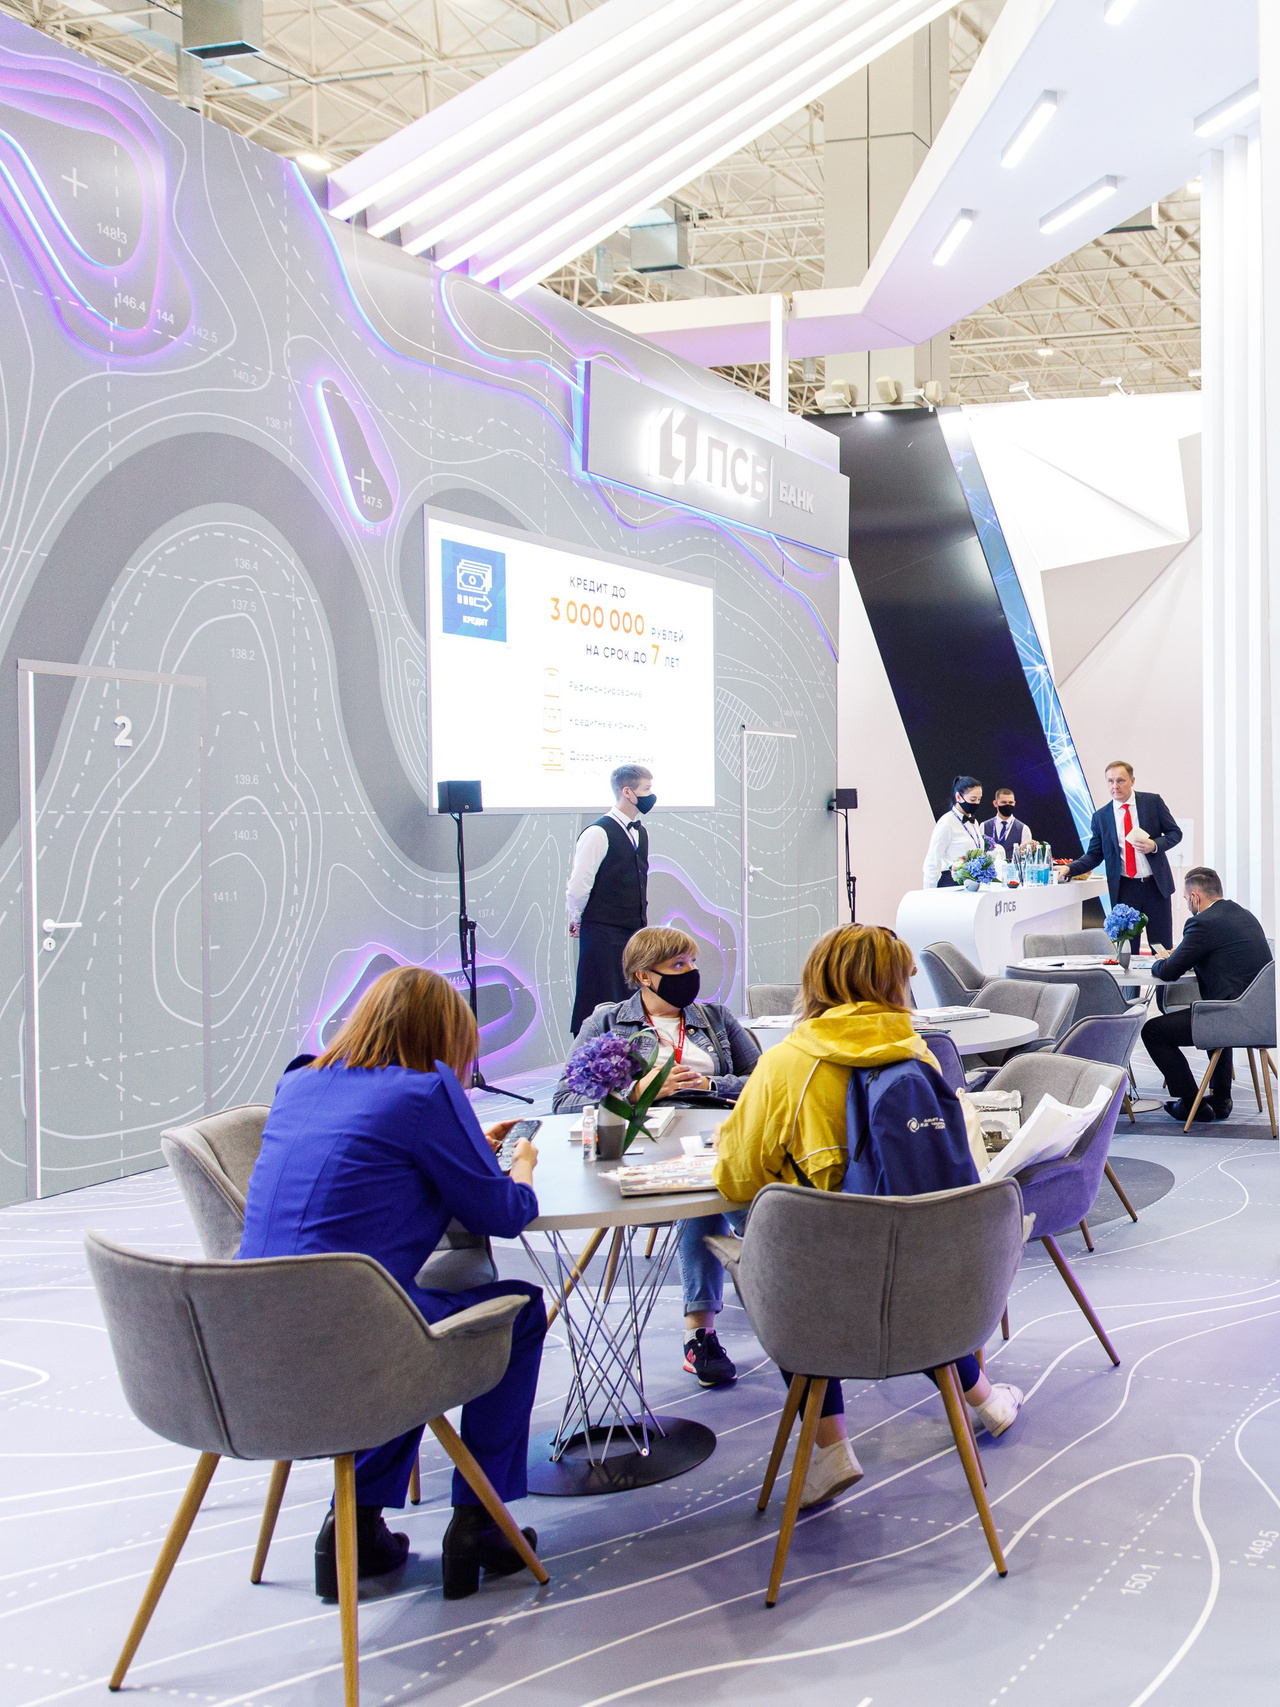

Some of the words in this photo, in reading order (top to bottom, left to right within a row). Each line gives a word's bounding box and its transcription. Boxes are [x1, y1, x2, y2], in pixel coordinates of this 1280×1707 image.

[116, 293, 147, 312] 146.4
[156, 308, 175, 325] 144
[191, 324, 218, 343] 142.5
[232, 368, 257, 386] 140.2
[706, 435, 769, 502] ПСБ
[779, 480, 815, 514] БАНК
[361, 494, 383, 509] 147.5
[234, 557, 258, 571] 136.4
[570, 576, 608, 596] КРЕДИТ
[612, 586, 626, 599] ДО
[232, 599, 257, 613] 137.5
[462, 614, 489, 627] КРЕДИТ
[550, 597, 561, 621] 3
[566, 600, 604, 629] 000
[610, 609, 644, 636] 000
[651, 627, 684, 643] РУБЛЕЙ
[230, 647, 255, 661] 138.2
[586, 644, 599, 656] НА
[603, 647, 630, 662] СРОК
[633, 652, 647, 664] ДО
[651, 645, 659, 665] 7
[664, 656, 680, 668] ЛЕТ
[114, 716, 133, 747] 2
[234, 774, 259, 787] 139.6
[233, 829, 258, 842] 140.3
[1003, 901, 1017, 912] ПСБ
[1244, 1530, 1280, 1561] 149.5
[1120, 1563, 1161, 1595] 150.1
